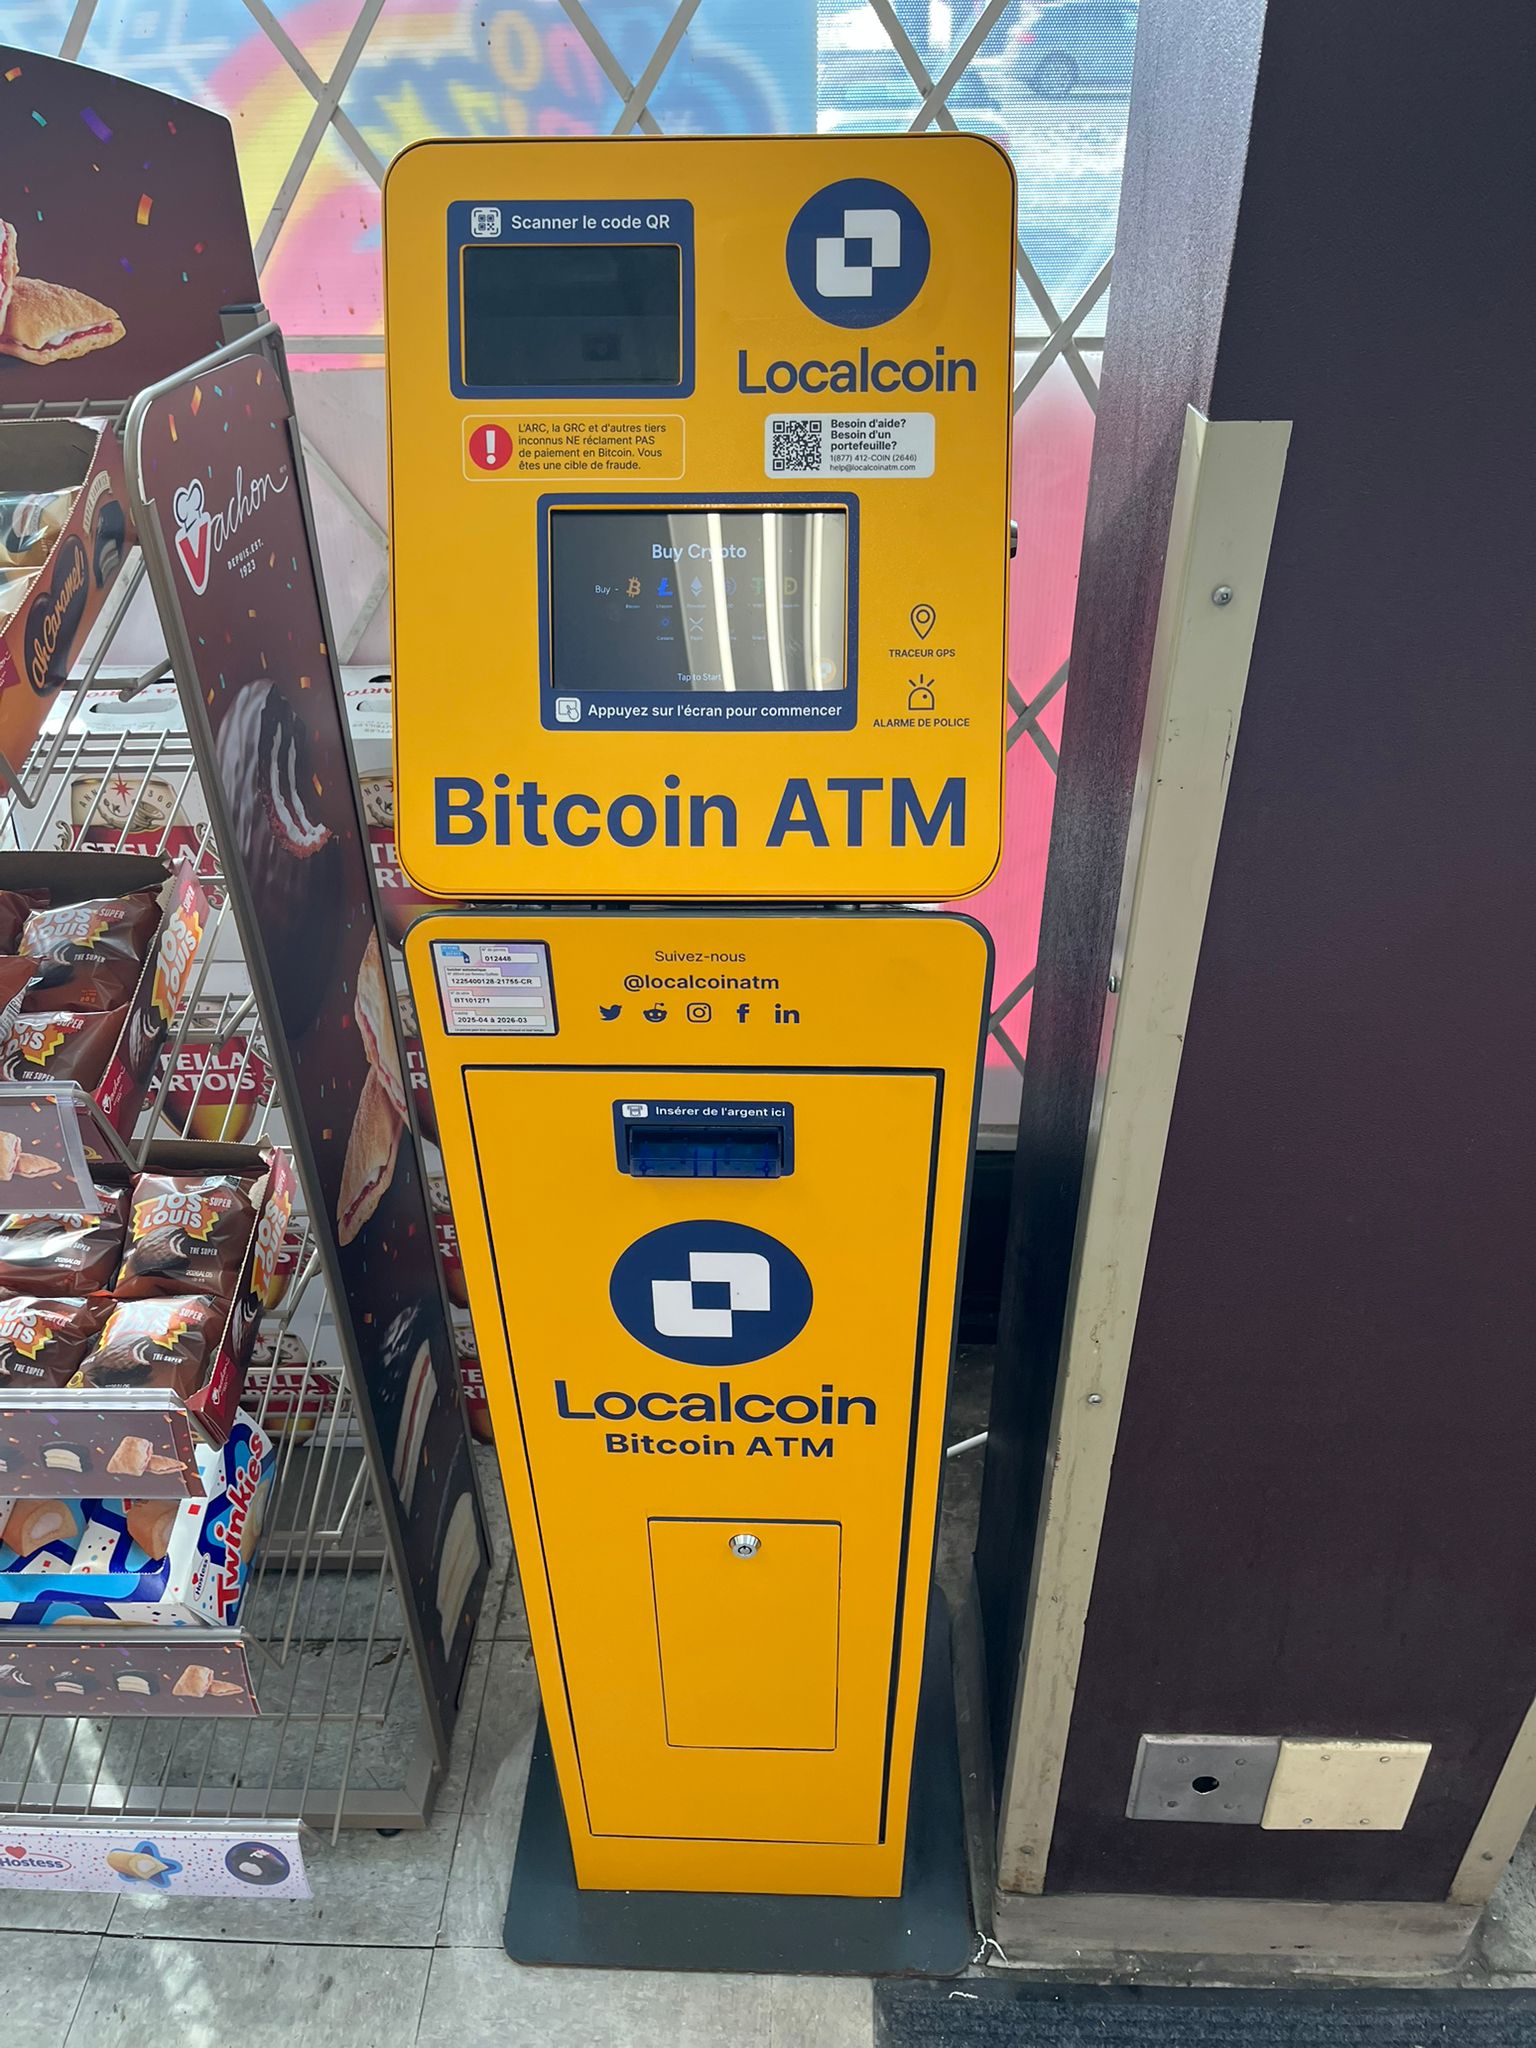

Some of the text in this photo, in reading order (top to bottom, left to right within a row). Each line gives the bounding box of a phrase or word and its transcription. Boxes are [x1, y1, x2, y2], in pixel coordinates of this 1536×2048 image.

[511, 215, 670, 230] Scanner le code QR
[738, 346, 977, 394] Localcoin
[518, 423, 666, 434] L'ARC, la GRC et d'autres tiers
[831, 419, 906, 429] Besoin d'aide?
[518, 435, 655, 445] inconnus NE réclament PAS
[831, 430, 891, 439] Besoin d'un
[830, 441, 897, 452] portefeuille?
[519, 448, 662, 459] de paiement en Bitcoin. Vous
[830, 453, 917, 462] 1(877) 412-COIN (2646)
[519, 460, 641, 471] êtes une cible de fraude.
[829, 463, 916, 472] help@localcoinatm.com
[652, 544, 683, 563] Buy
[240, 559, 256, 579] 1923
[595, 585, 611, 595] Buy
[889, 649, 956, 658] TRACEUR GPS
[677, 673, 722, 683] Tap to Start
[588, 704, 842, 721] Appuyez sur l'écran pour commencer
[873, 718, 970, 728] ALARME DE POLICE
[434, 773, 967, 848] Bitcoin ATM
[99, 908, 125, 919] SUPER
[156, 912, 187, 979] JOS
[86, 954, 106, 963] SUPER
[655, 950, 746, 963] Suivez-nous
[167, 930, 197, 1009] LOUIS
[623, 975, 780, 992] @localcoinatm
[159, 1053, 252, 1071] TELLA
[22, 1070, 34, 1078] THE
[655, 1106, 786, 1117] Insérer de l'argent ici
[153, 1194, 202, 1212] JOS
[209, 1196, 233, 1209] SUPER
[143, 1210, 204, 1229] LOUIS
[255, 1200, 281, 1269] JOS
[190, 1247, 218, 1257] THE SUPER
[262, 1213, 287, 1289] LOUIS
[180, 1308, 203, 1322] SUPER
[152, 1352, 164, 1361] THE
[14, 1363, 45, 1377] THE SUPER
[245, 1374, 319, 1388] TELLA
[554, 1380, 877, 1426] Localcoin
[605, 1433, 834, 1458] Bitcoin ATM
[217, 1433, 264, 1619] Twinkies
[195, 1557, 209, 1596] Hostess
[0, 1857, 64, 1869] Hostess
